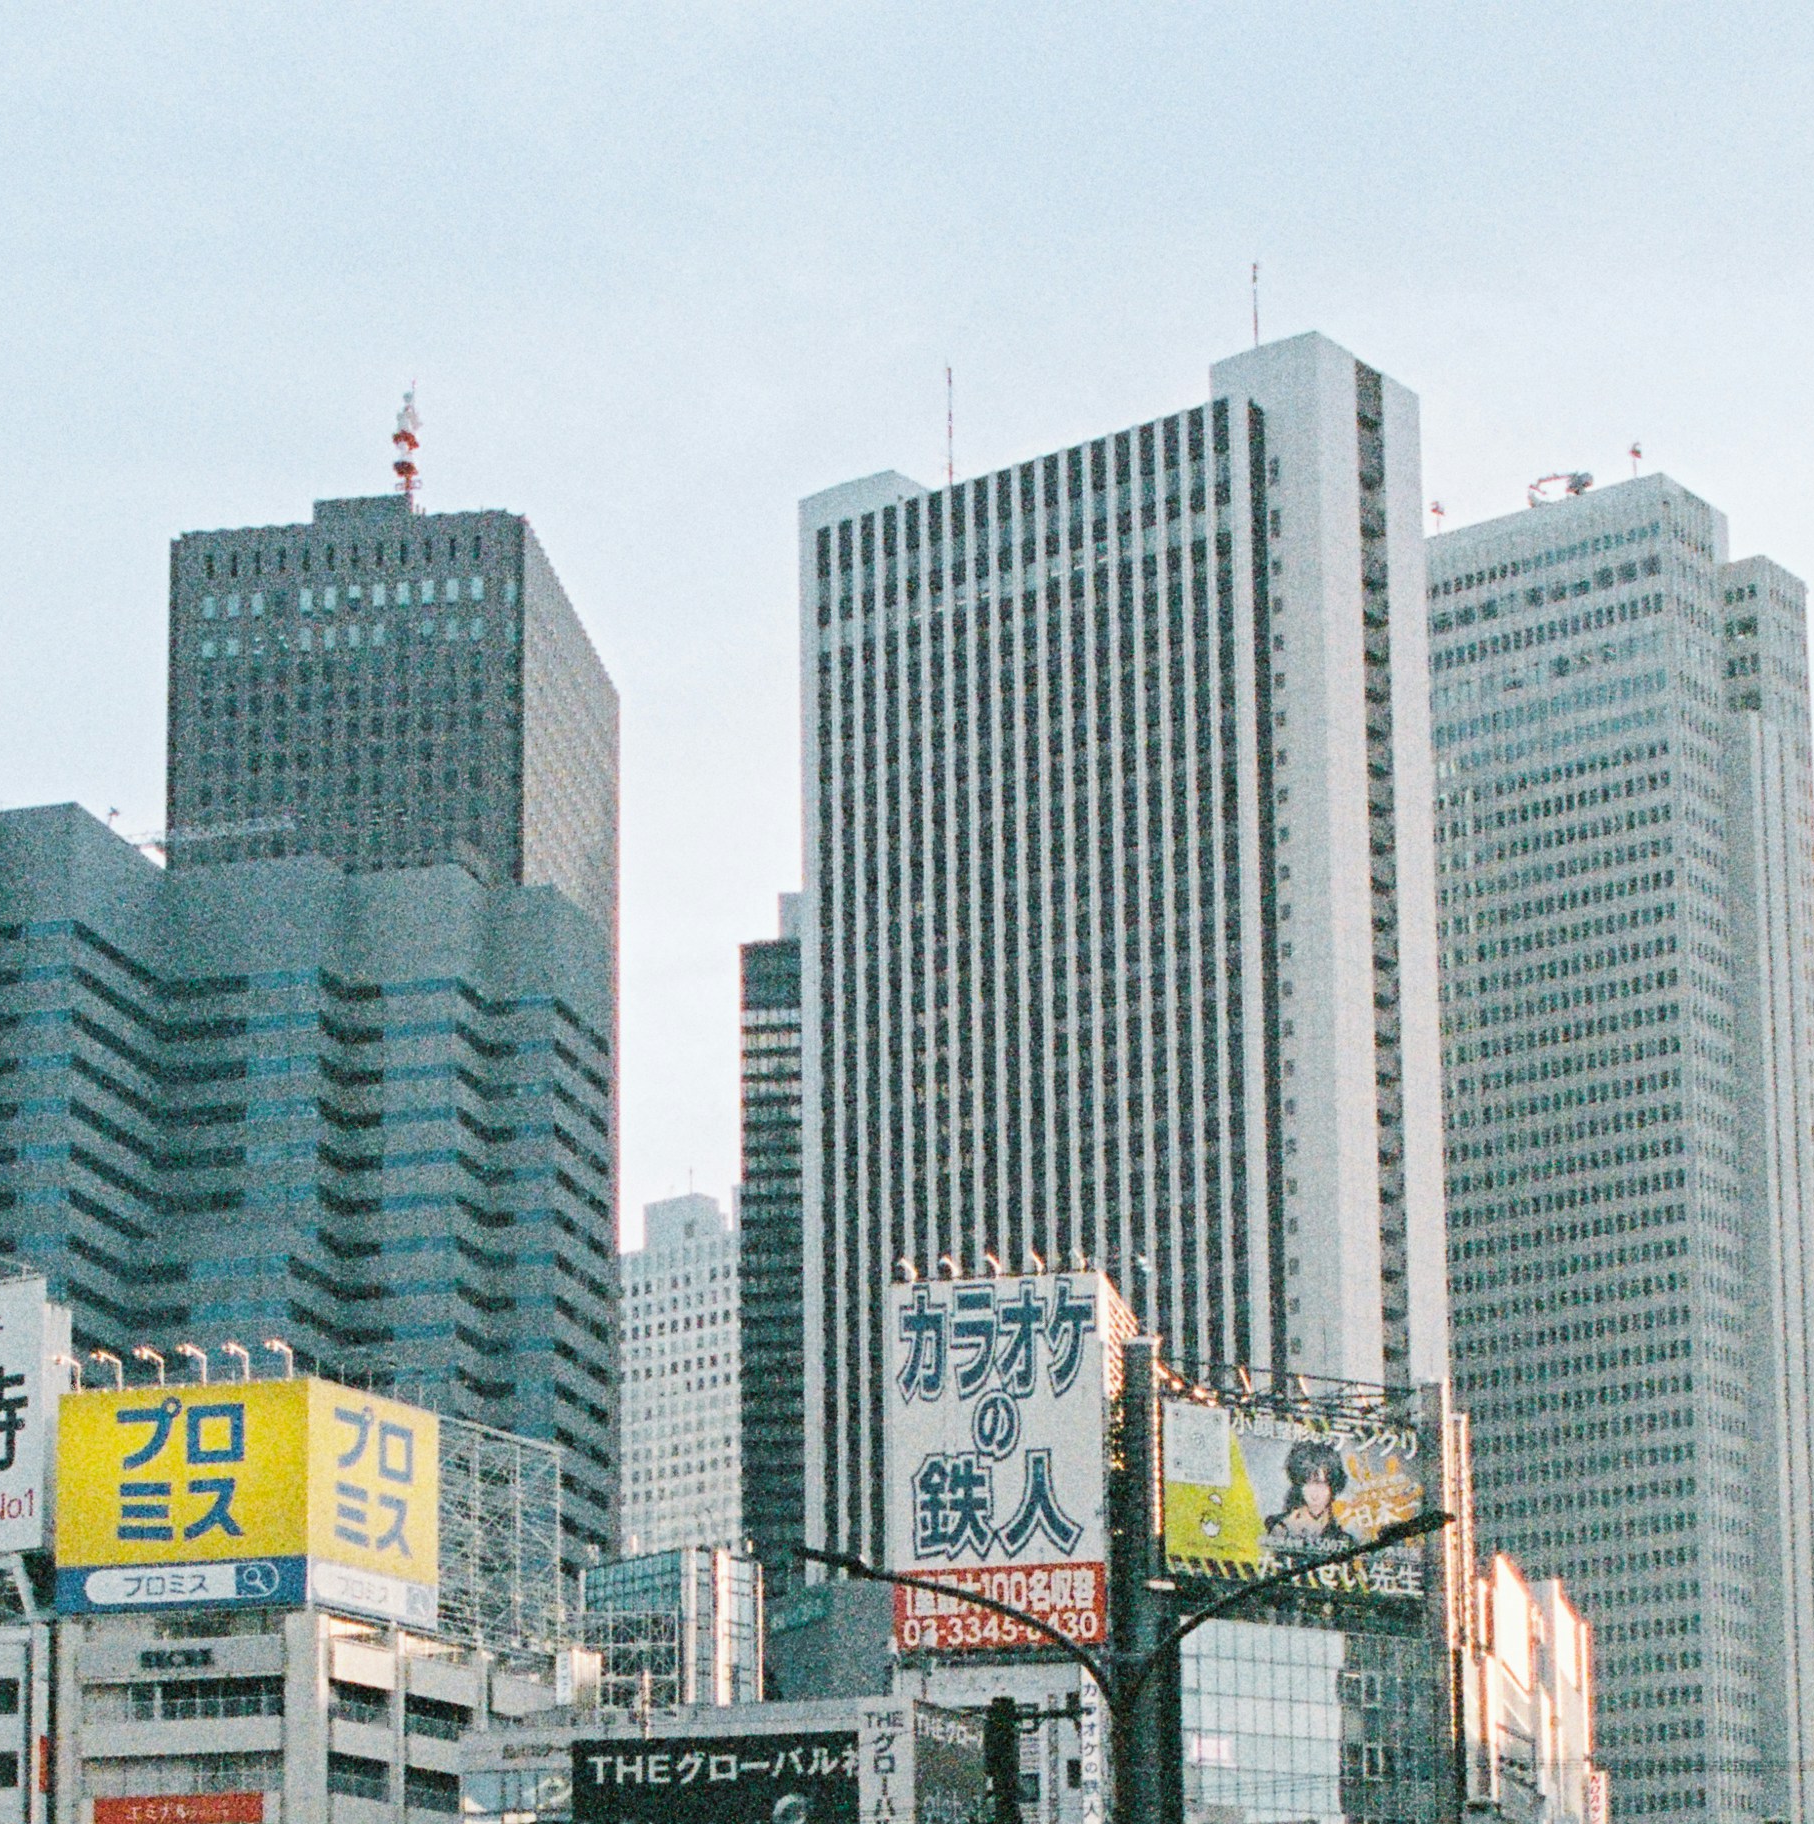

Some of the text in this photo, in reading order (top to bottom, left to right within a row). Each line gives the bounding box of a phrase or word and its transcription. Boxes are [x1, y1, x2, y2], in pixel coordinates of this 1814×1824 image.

[897, 1281, 1098, 1402] カラオケ
[116, 1397, 245, 1470] プロ
[971, 1395, 1020, 1462] の
[117, 1475, 244, 1542] ミス
[912, 1451, 1083, 1561] 鉄人
[123, 1573, 209, 1600] プロミス
